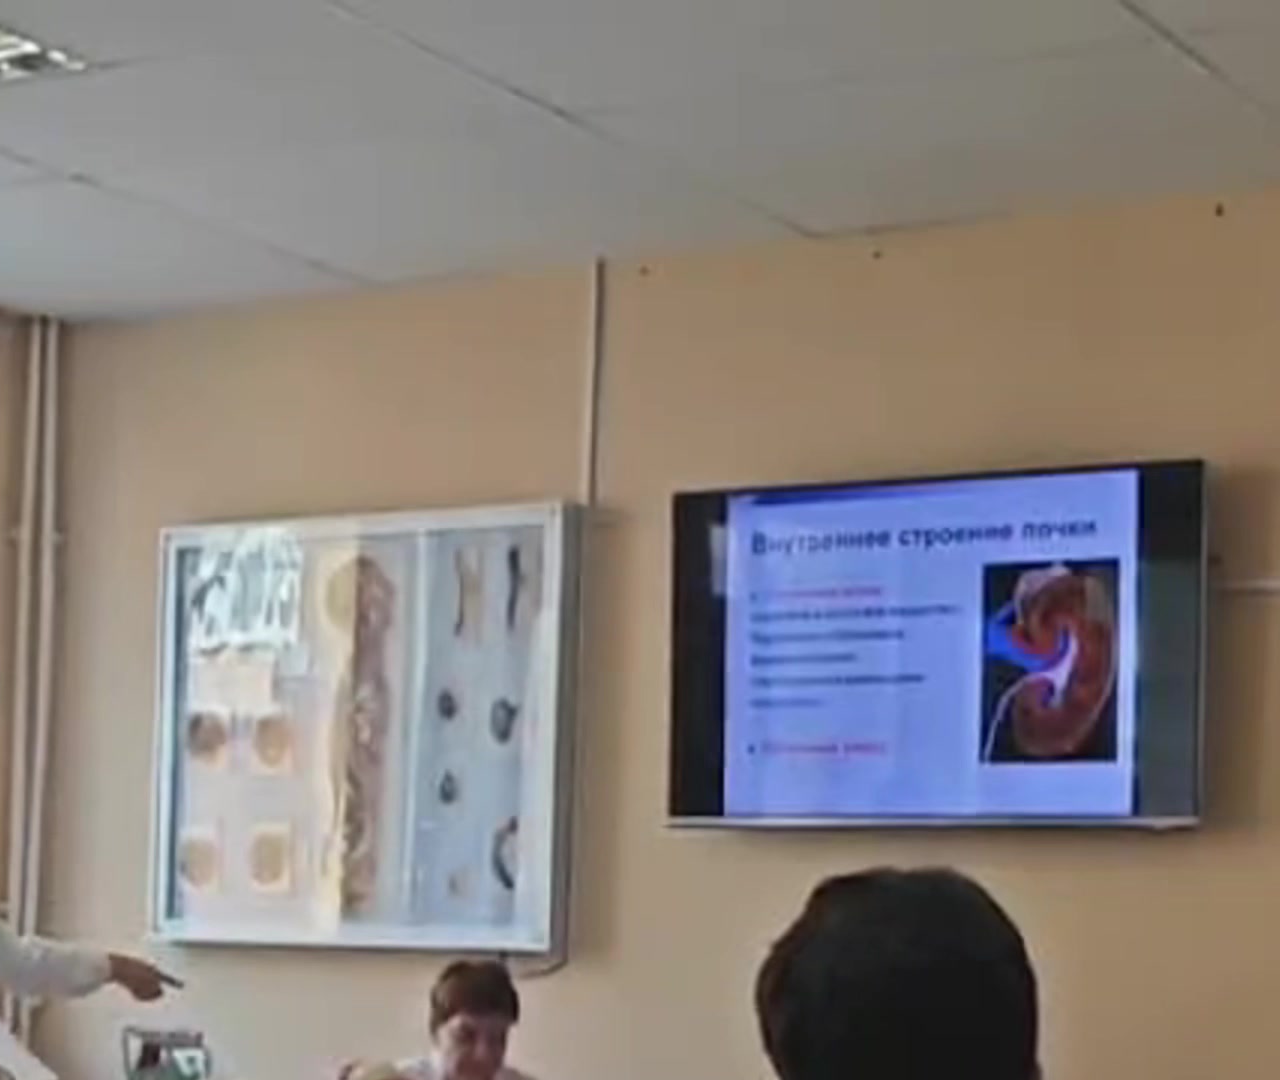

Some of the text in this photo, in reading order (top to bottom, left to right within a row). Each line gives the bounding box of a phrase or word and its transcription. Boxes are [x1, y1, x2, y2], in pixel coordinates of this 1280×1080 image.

[751, 519, 1097, 555] Внутреннее строение почки
